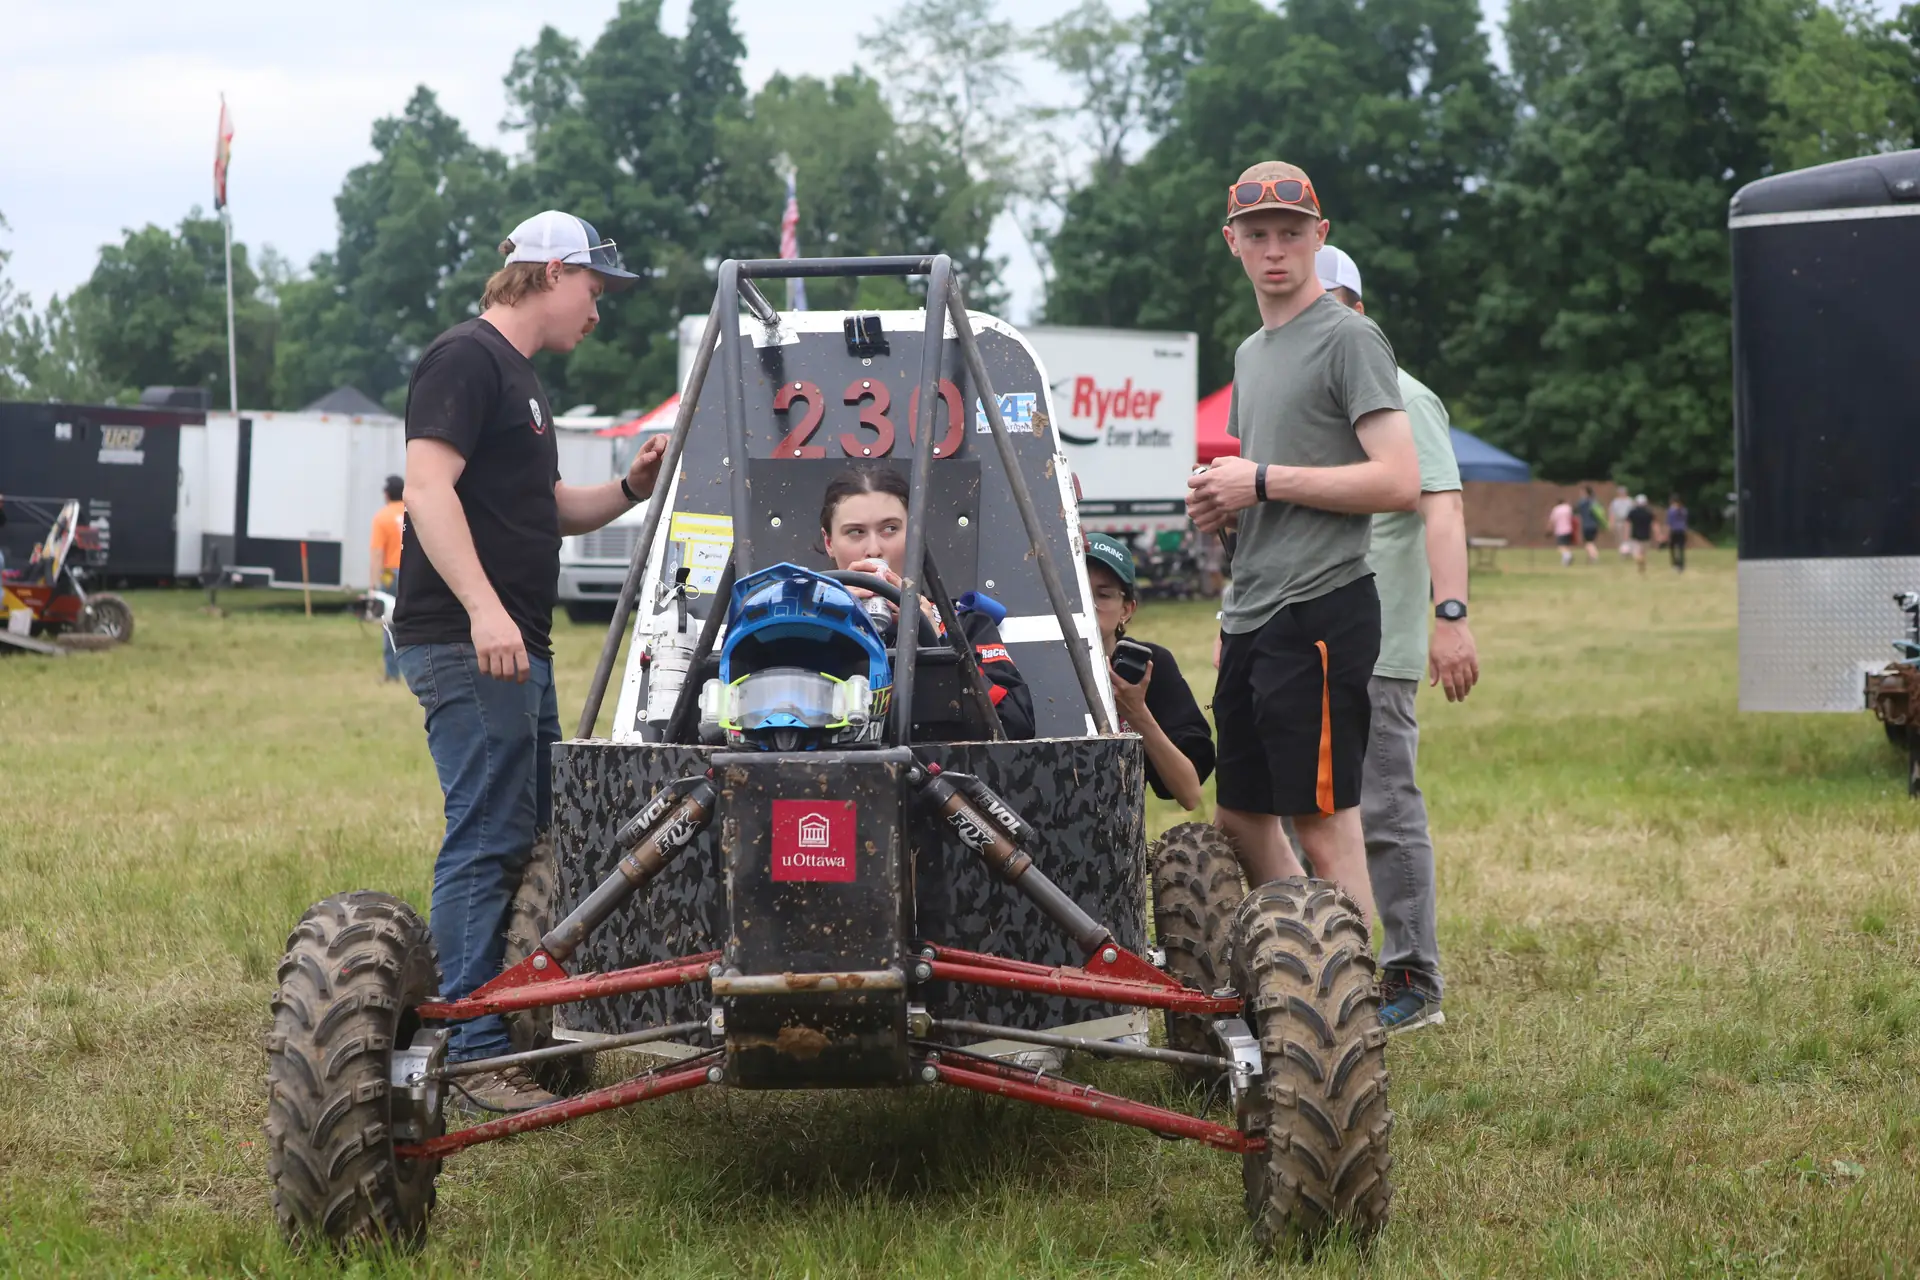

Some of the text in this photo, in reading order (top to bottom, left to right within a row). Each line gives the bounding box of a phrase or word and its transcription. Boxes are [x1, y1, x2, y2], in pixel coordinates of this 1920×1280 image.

[770, 377, 965, 460] 230
[1072, 376, 1162, 429] Ryder
[1094, 542, 1124, 562] LORING
[627, 798, 672, 840] EVOL
[655, 809, 701, 857] FOX
[946, 810, 995, 856] FOX
[976, 790, 1021, 835] EVOL
[781, 853, 846, 867] uOttawa
